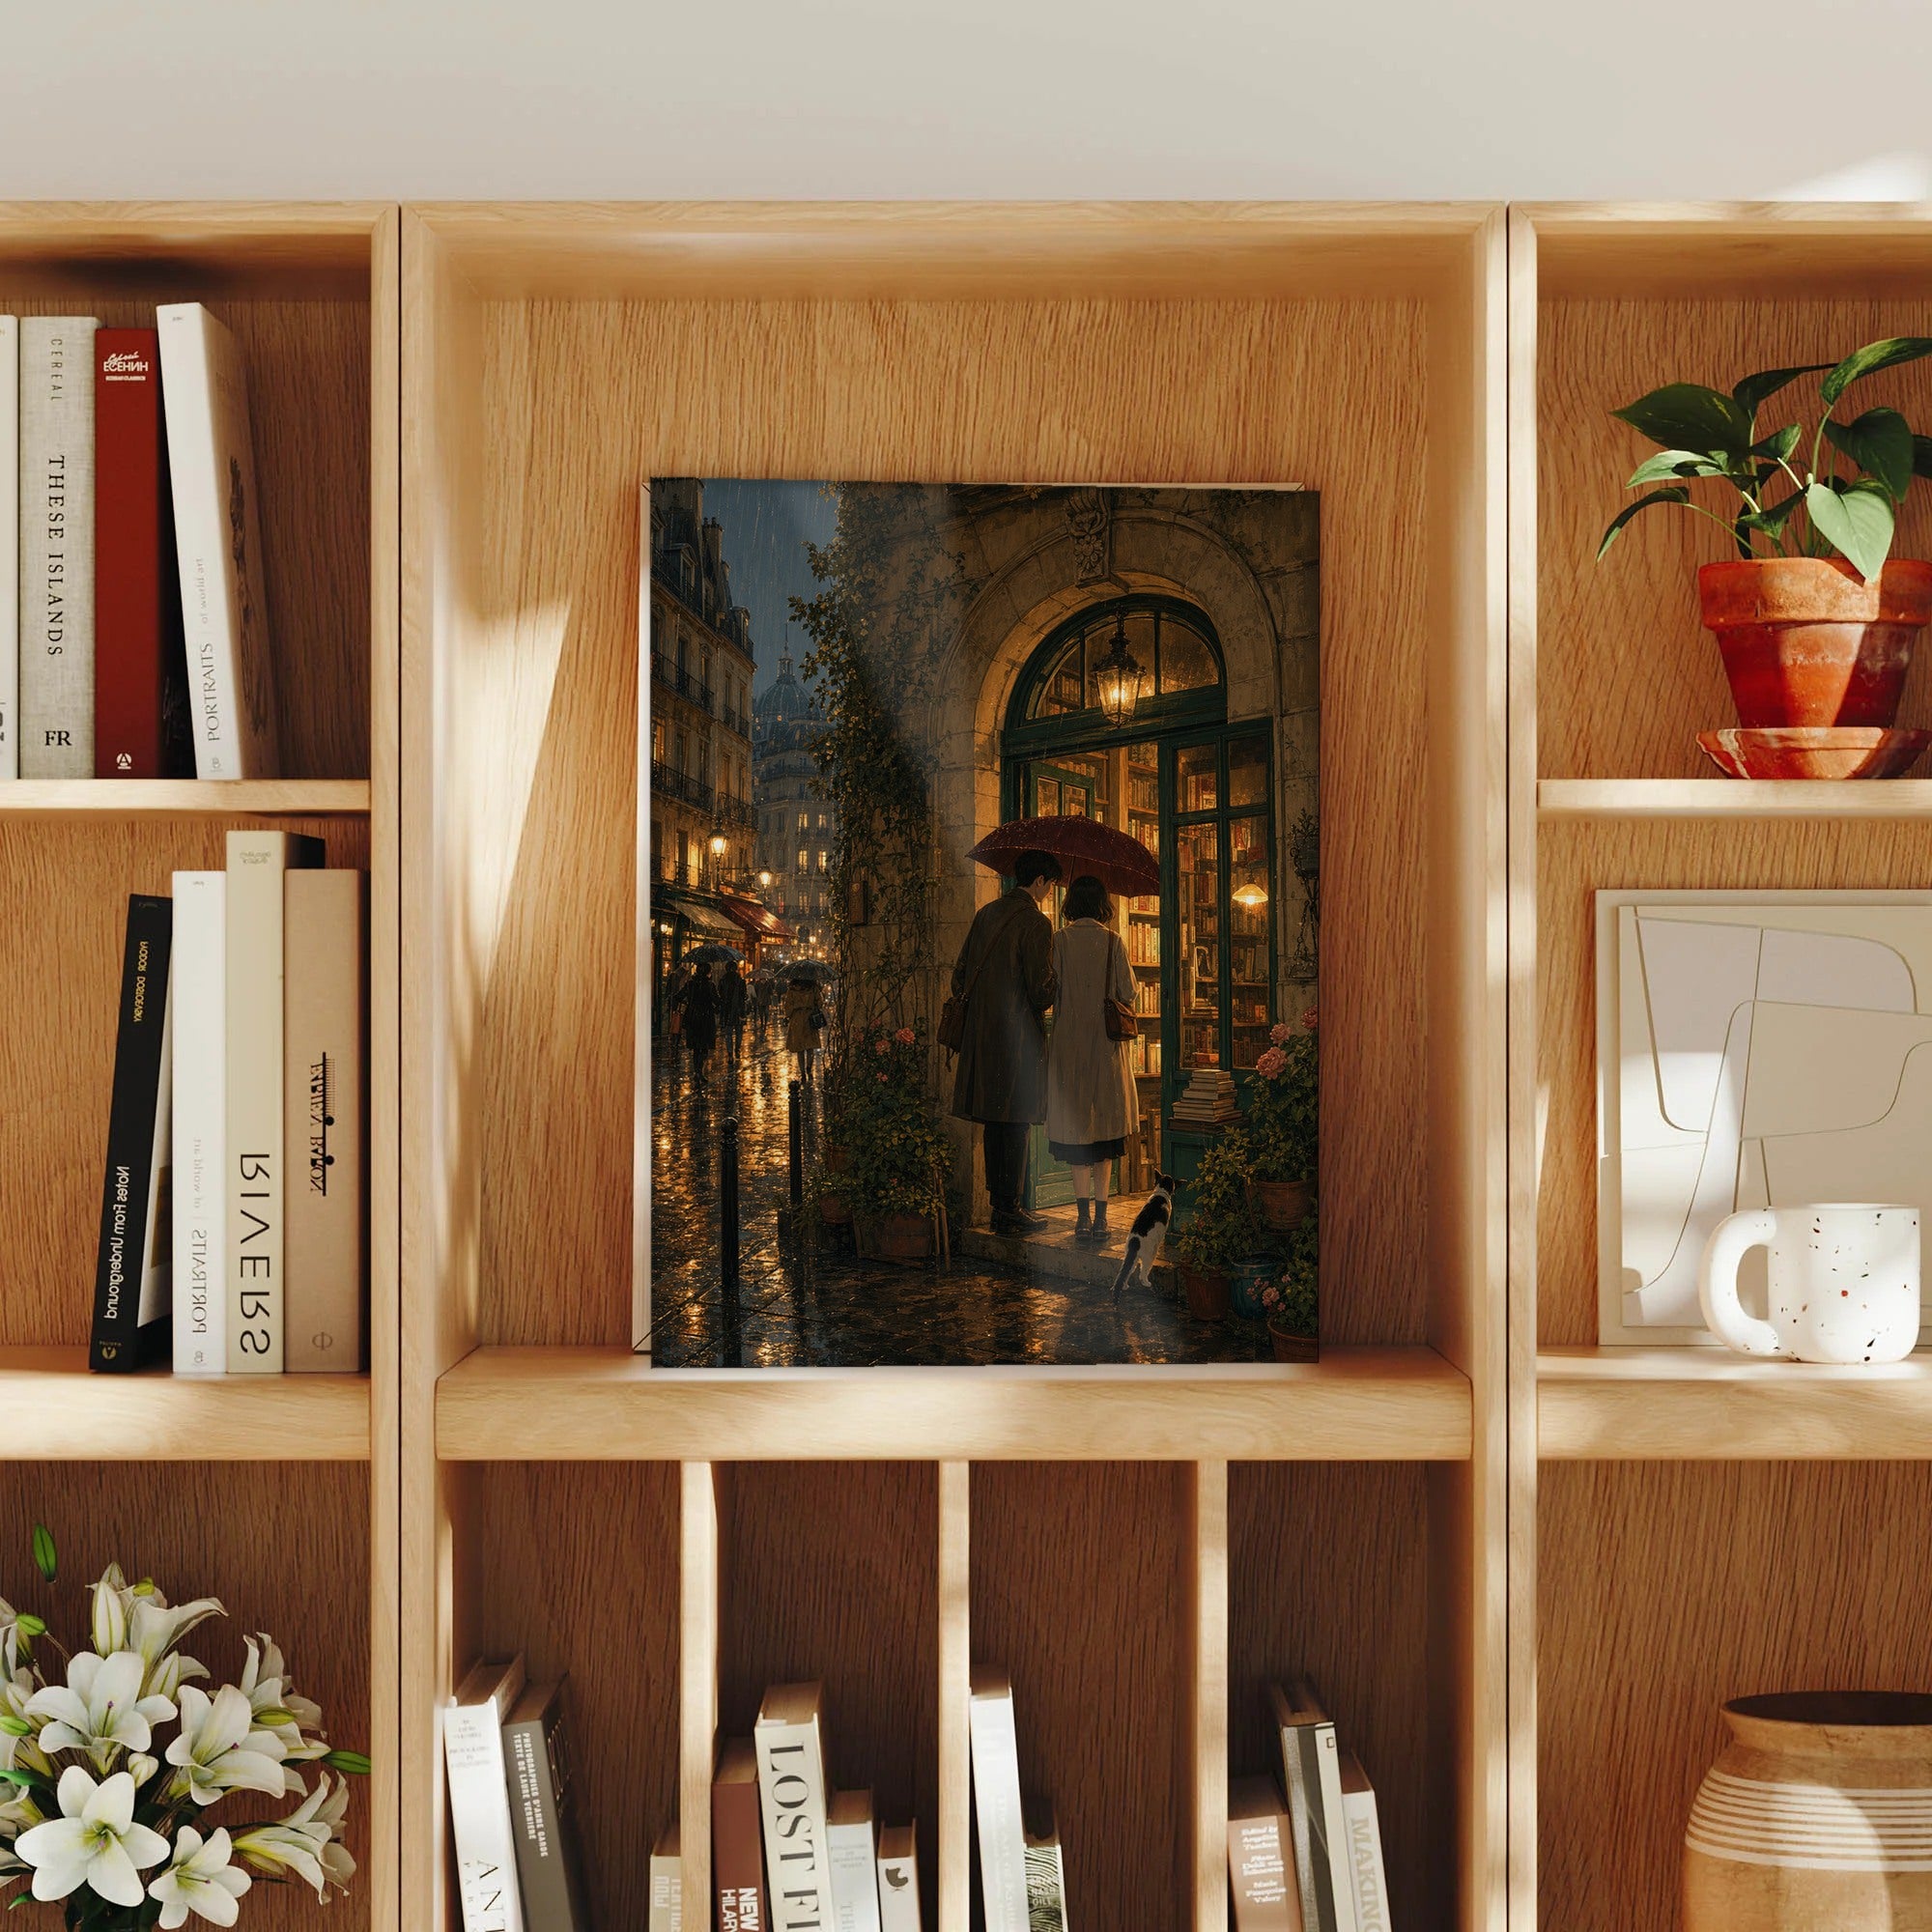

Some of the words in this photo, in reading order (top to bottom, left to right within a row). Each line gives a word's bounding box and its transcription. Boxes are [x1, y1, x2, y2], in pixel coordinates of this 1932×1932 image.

[50, 338, 63, 401] CEREAL
[103, 361, 149, 372] ЕСЕНИН
[48, 455, 65, 539] THESE
[47, 554, 64, 656] ISLANDS
[200, 642, 220, 742] PORTRAITS
[44, 730, 72, 746] FR
[522, 1732, 540, 1798] PHOTOGRAPHIES
[769, 1740, 816, 1871] LOST
[738, 1887, 759, 1931] NEW
